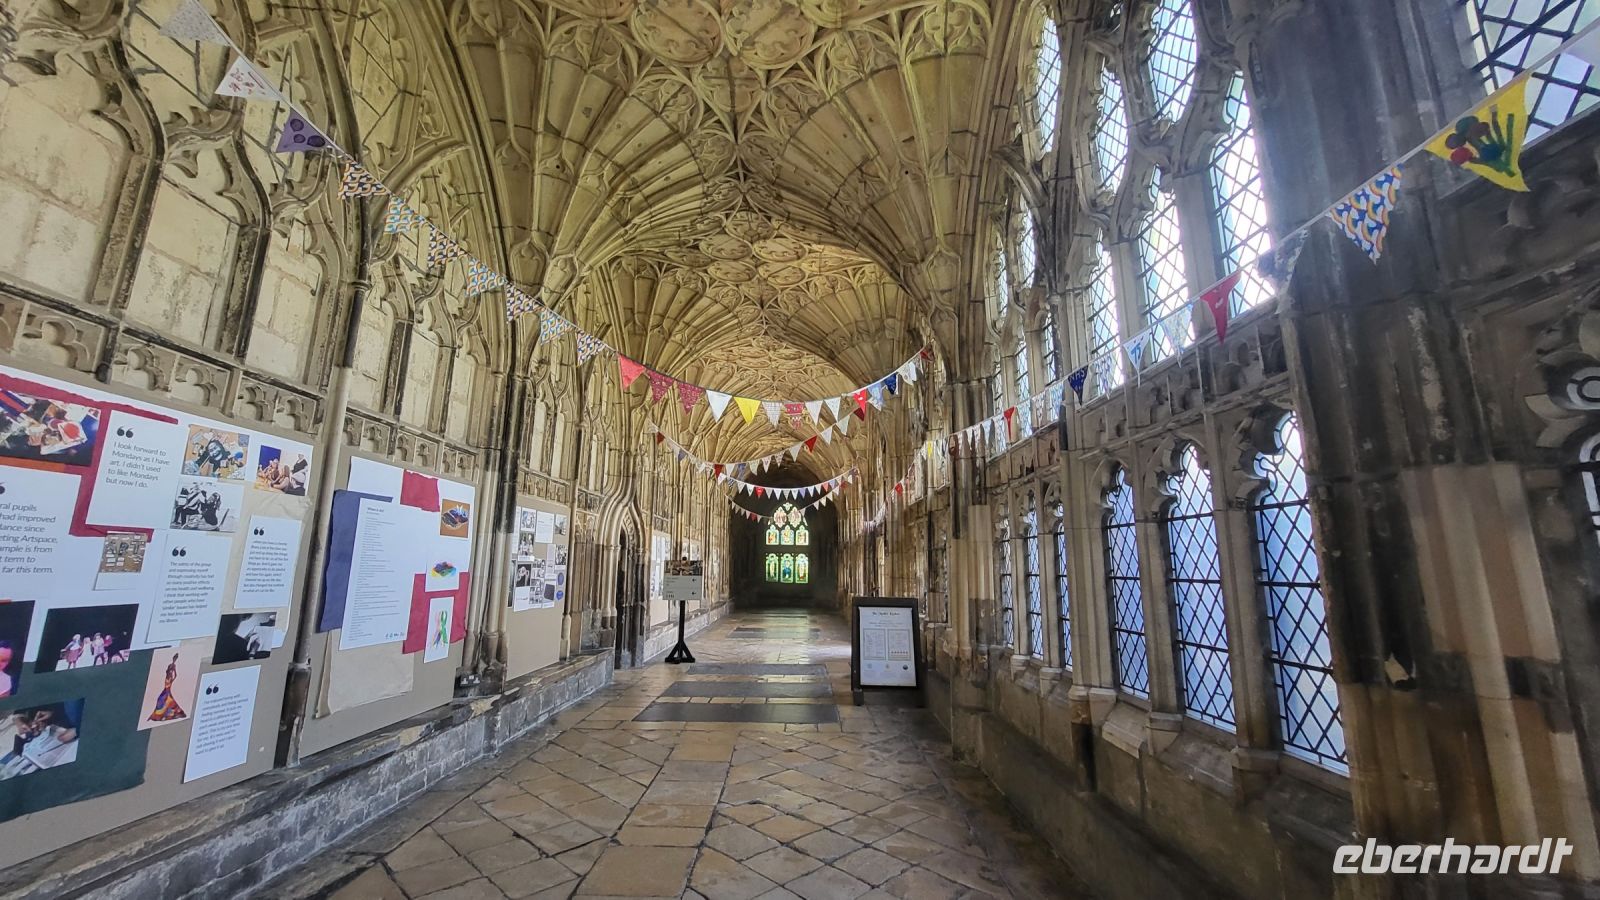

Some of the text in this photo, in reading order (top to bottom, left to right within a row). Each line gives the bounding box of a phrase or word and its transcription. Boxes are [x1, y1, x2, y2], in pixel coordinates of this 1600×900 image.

[134, 445, 158, 454] forward
[112, 450, 142, 460] Mondays
[126, 462, 145, 470] didn't
[130, 471, 158, 481] Mondays
